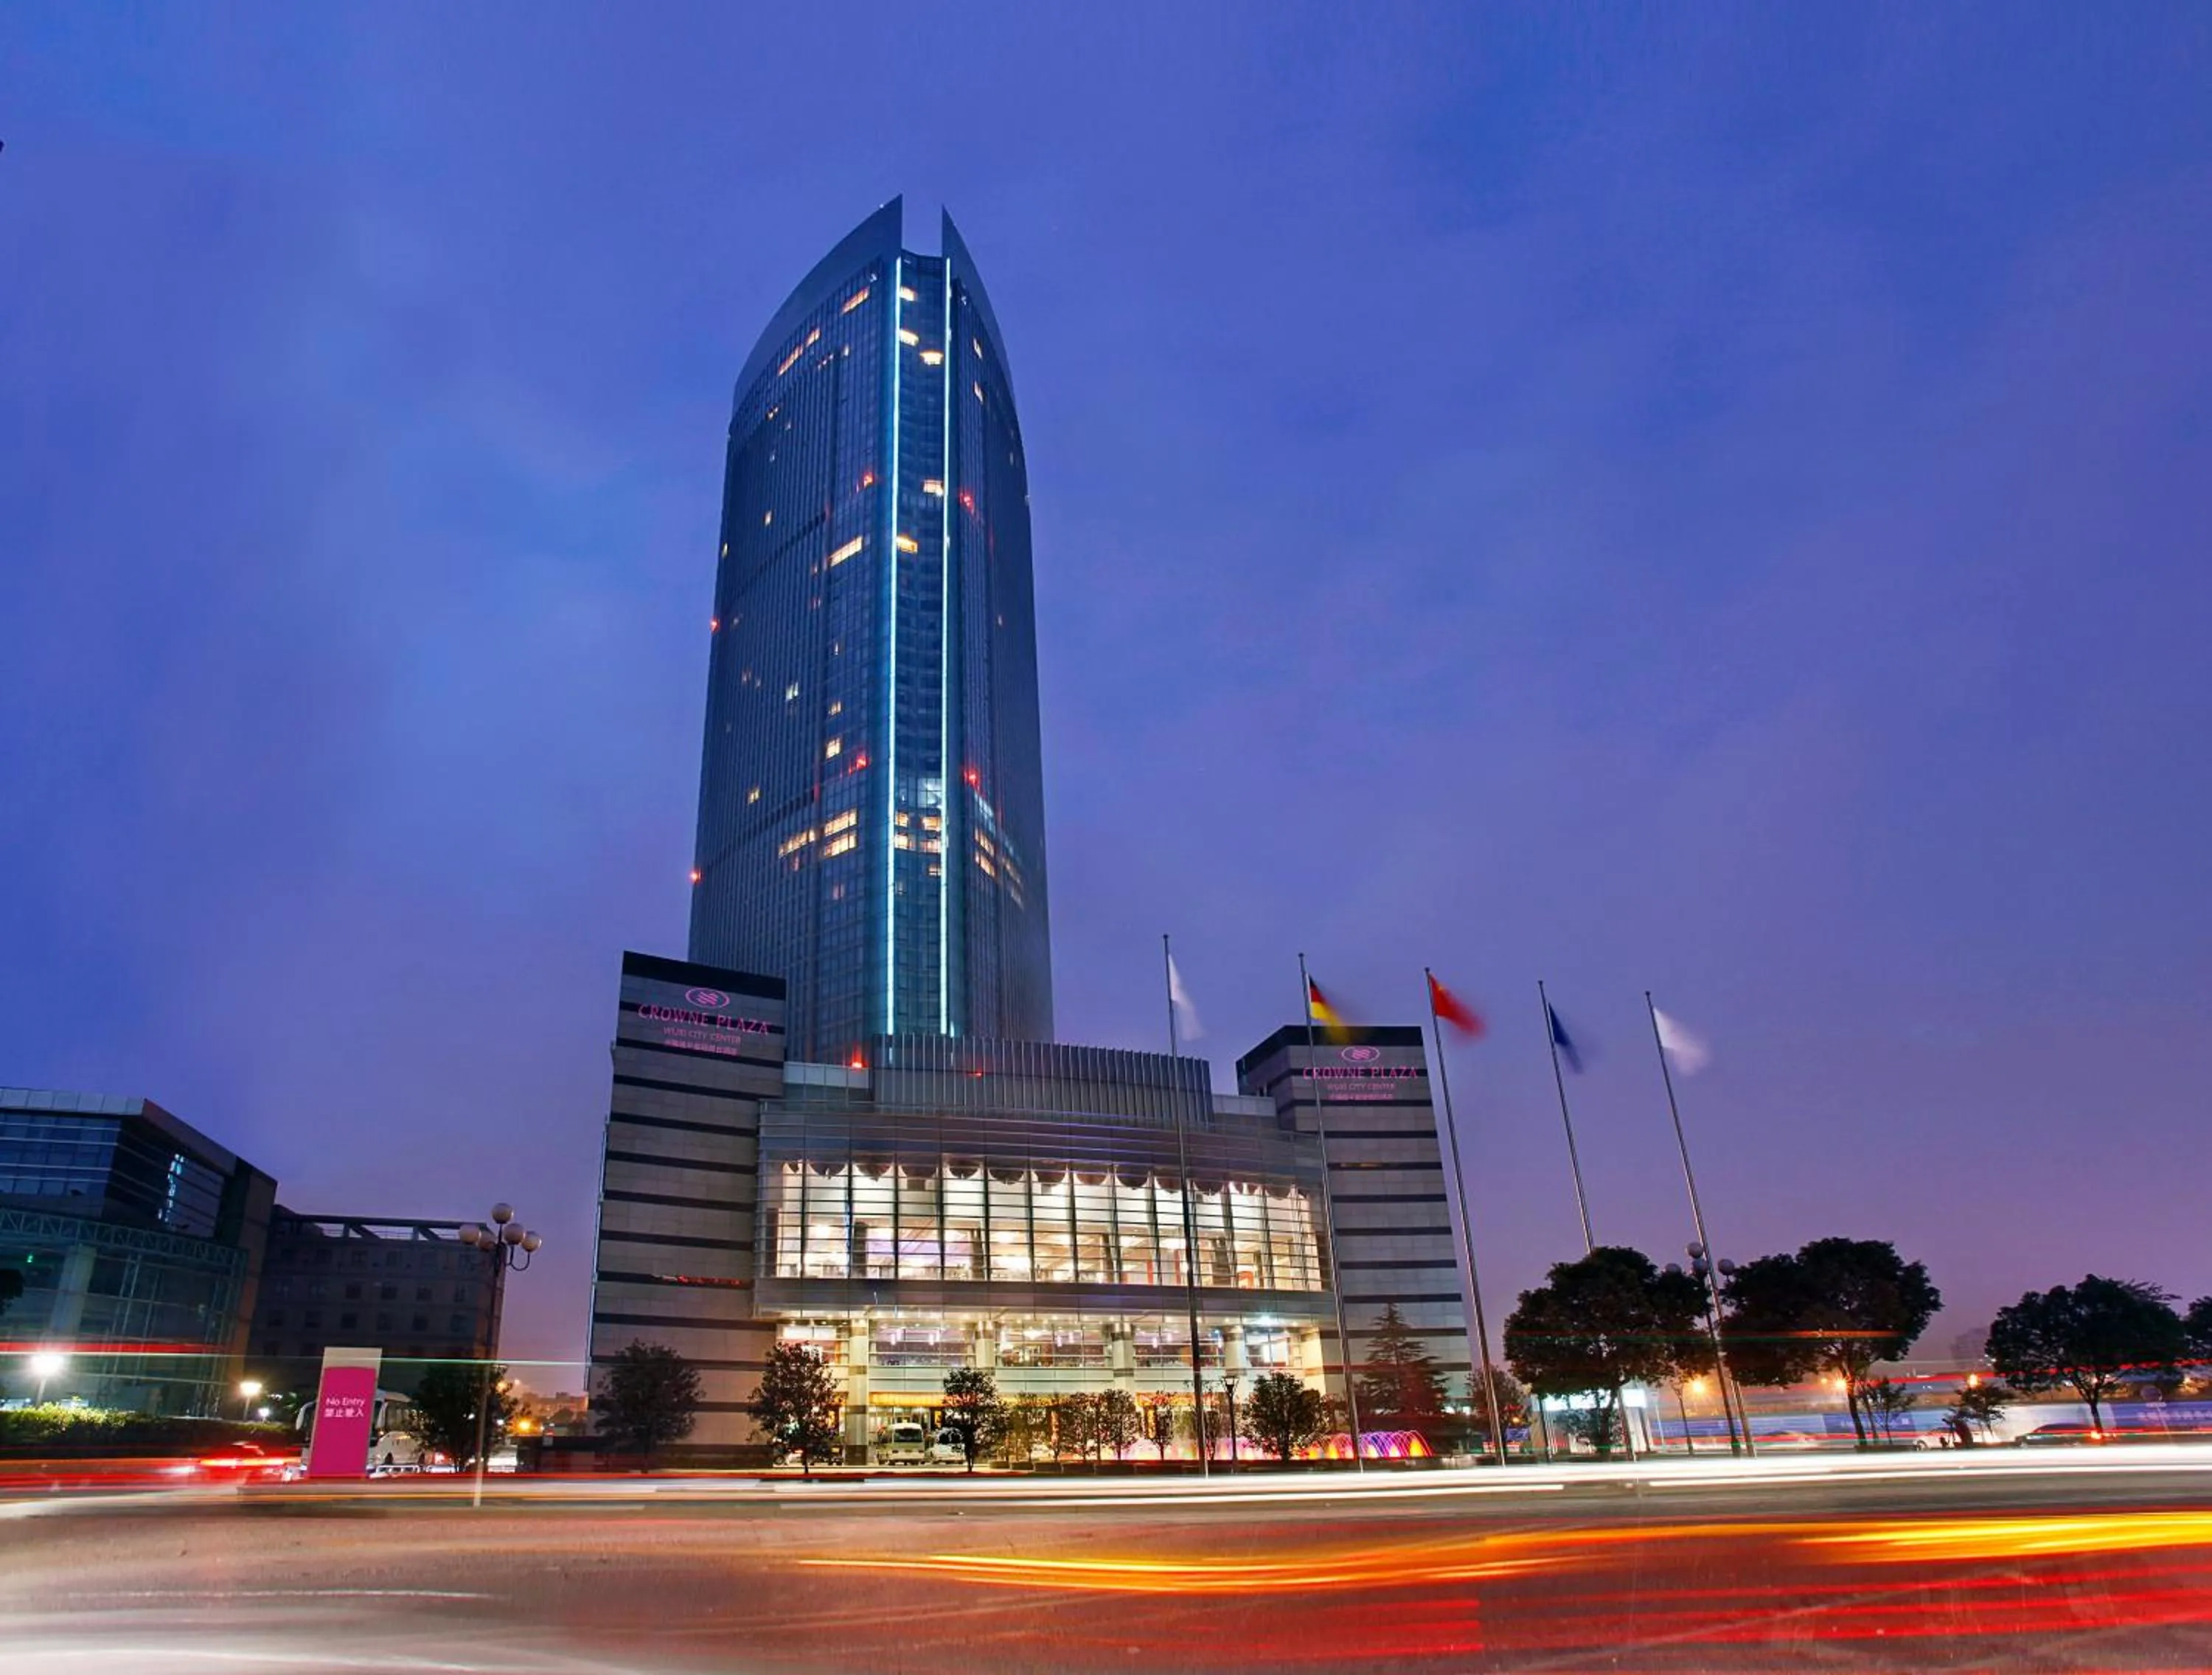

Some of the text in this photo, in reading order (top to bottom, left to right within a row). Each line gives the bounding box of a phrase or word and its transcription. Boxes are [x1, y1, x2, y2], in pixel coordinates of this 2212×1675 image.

[638, 1003, 770, 1035] CROWNE PLAZA
[1302, 1066, 1419, 1080] CROWNE PLAZA
[325, 1397, 366, 1407] No Entry
